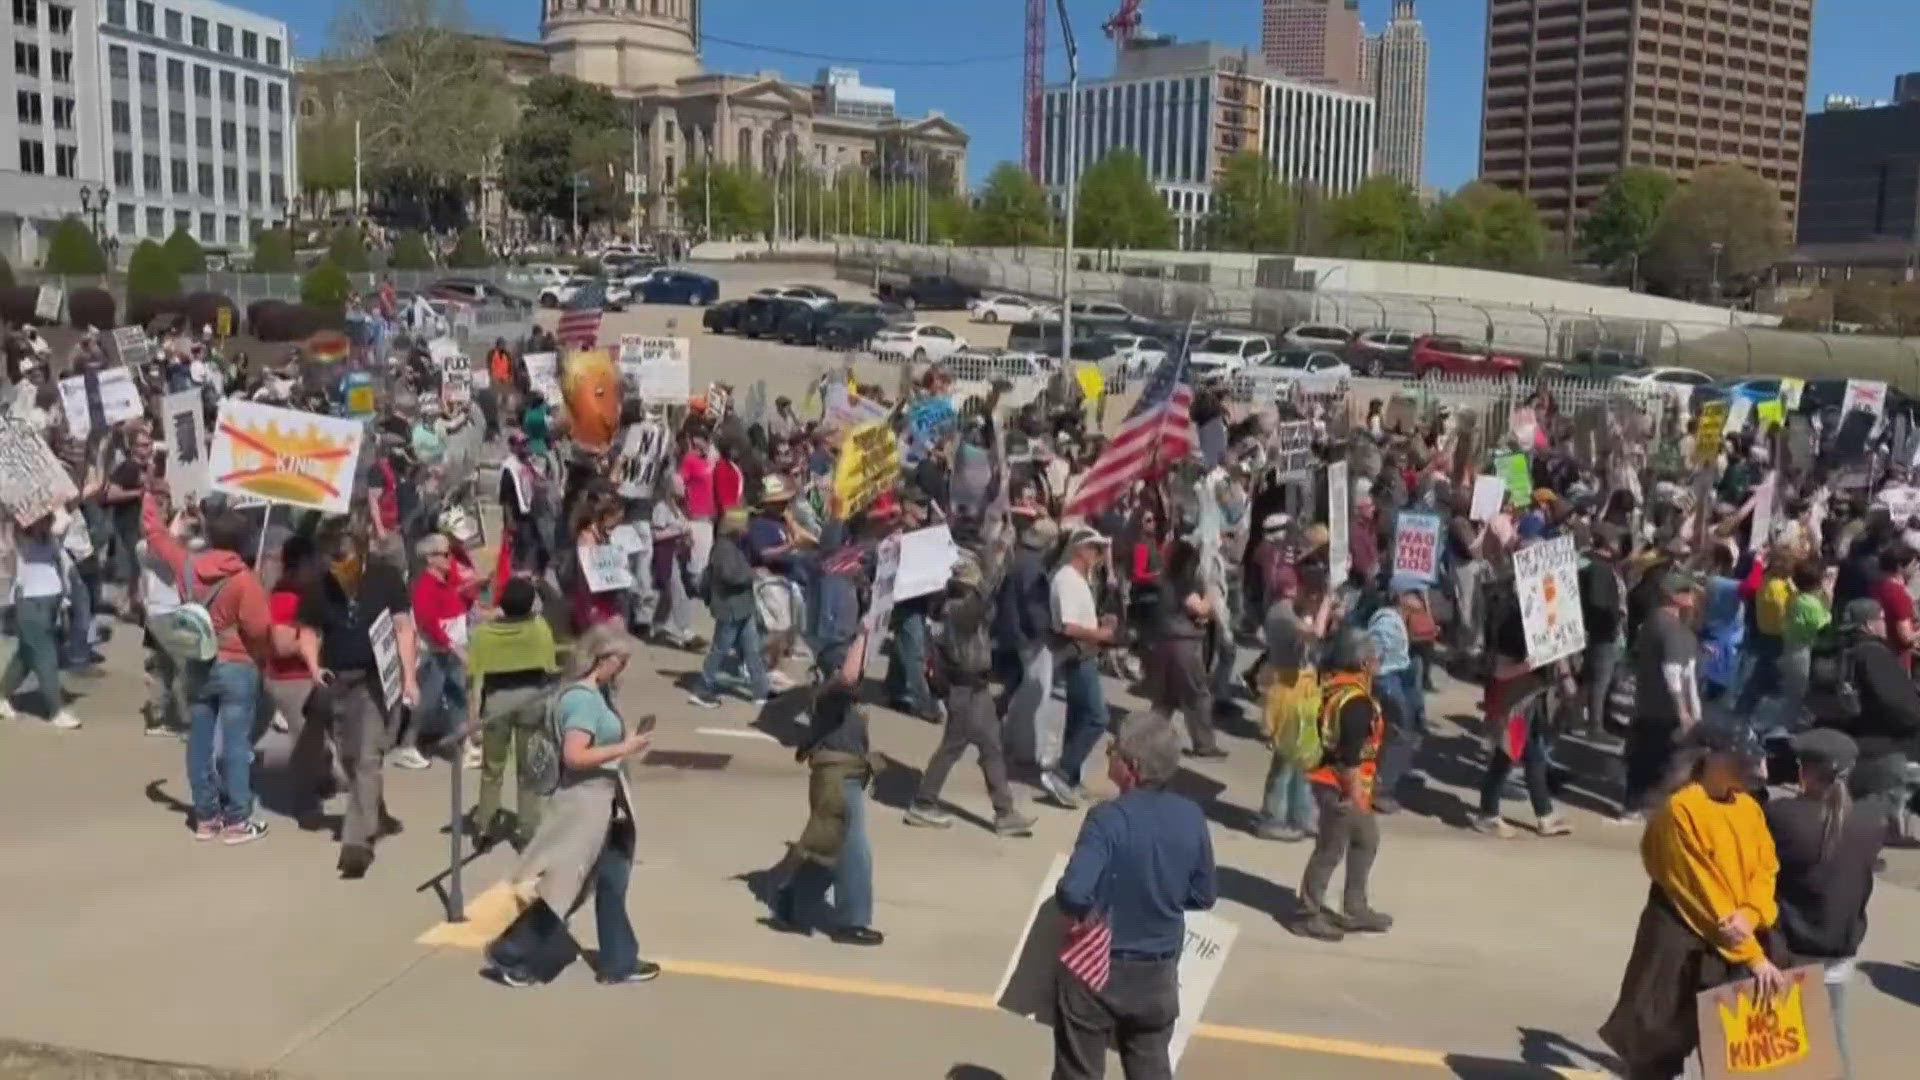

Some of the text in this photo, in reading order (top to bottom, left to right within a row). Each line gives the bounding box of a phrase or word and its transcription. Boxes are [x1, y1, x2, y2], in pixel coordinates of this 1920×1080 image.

[643, 339, 675, 349] HANDS
[643, 349, 664, 360] OFF
[1399, 545, 1434, 559] THE
[1185, 928, 1221, 960] THE
[1745, 1011, 1779, 1035] NO
[1728, 1026, 1801, 1068] KINGS
